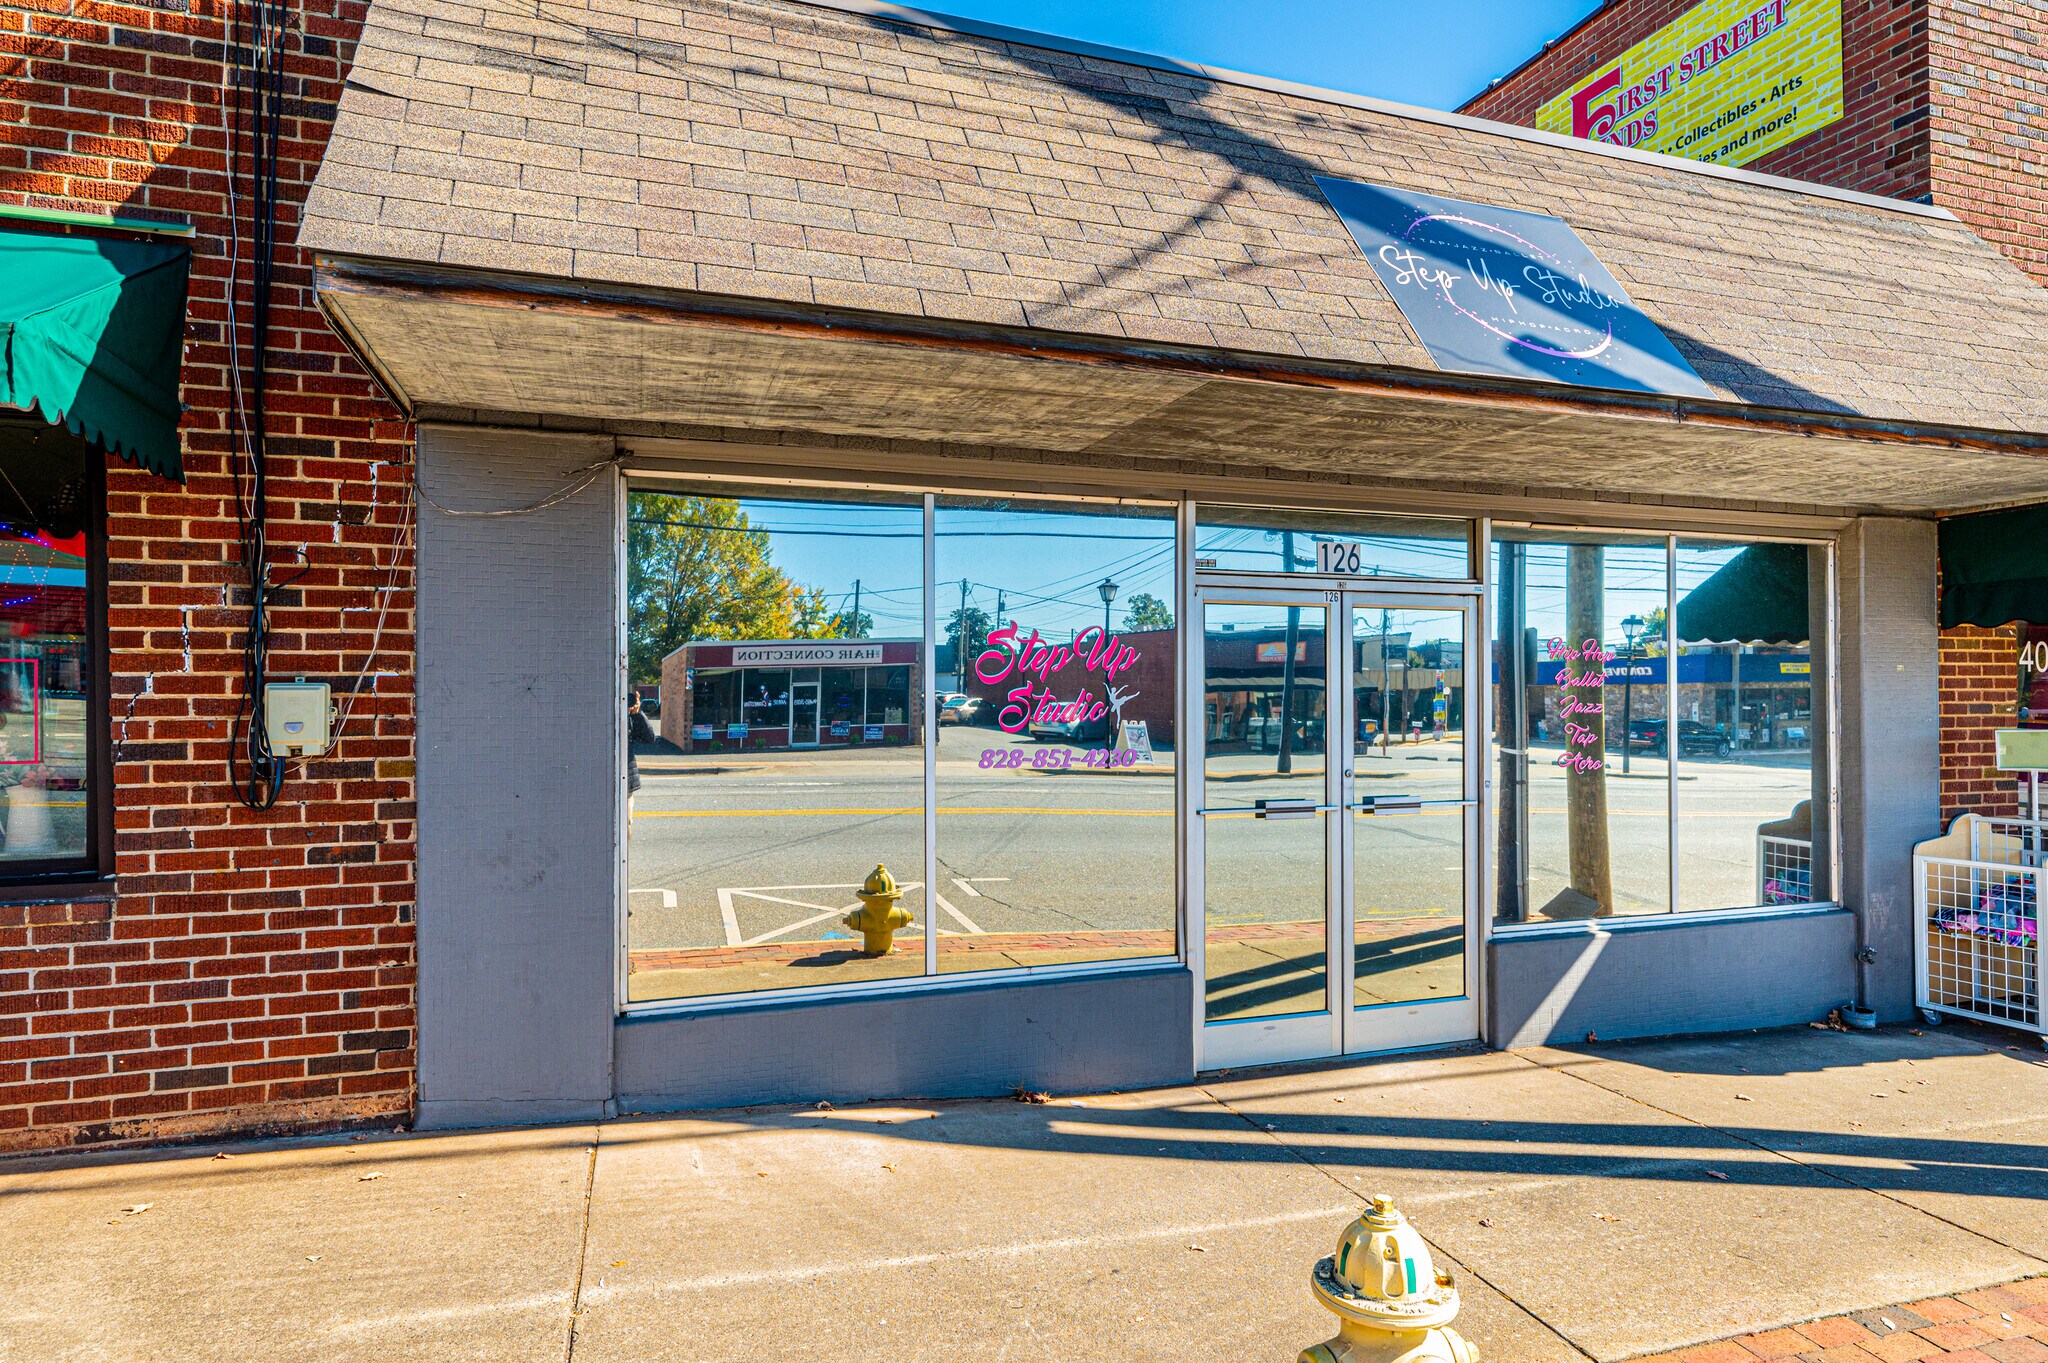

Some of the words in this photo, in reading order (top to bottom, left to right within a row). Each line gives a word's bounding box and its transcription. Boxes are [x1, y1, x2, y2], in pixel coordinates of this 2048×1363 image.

[1570, 65, 1675, 139] FIRST
[1679, 0, 1789, 83] STREET
[1675, 99, 1757, 150] Collectibles
[1770, 75, 1803, 102] Arts
[1721, 131, 1748, 156] and
[1752, 107, 1798, 141] more!
[1379, 245, 1461, 301] Step
[1467, 257, 1520, 314] Up
[1523, 265, 1624, 310] Studio
[1322, 543, 1360, 573] 126
[1325, 591, 1339, 603] 126
[975, 620, 1074, 684] Step
[1073, 625, 1141, 682] Up
[1546, 636, 1580, 661] Hip
[1580, 638, 1616, 665] Hop
[2018, 640, 2048, 673] 40
[1555, 667, 1608, 691] Ballet
[998, 681, 1110, 734] Studio
[1558, 695, 1604, 718] Jazz
[1563, 722, 1598, 748] Tap
[978, 748, 1138, 769] 828-851-4230
[1557, 751, 1605, 774] Acro
